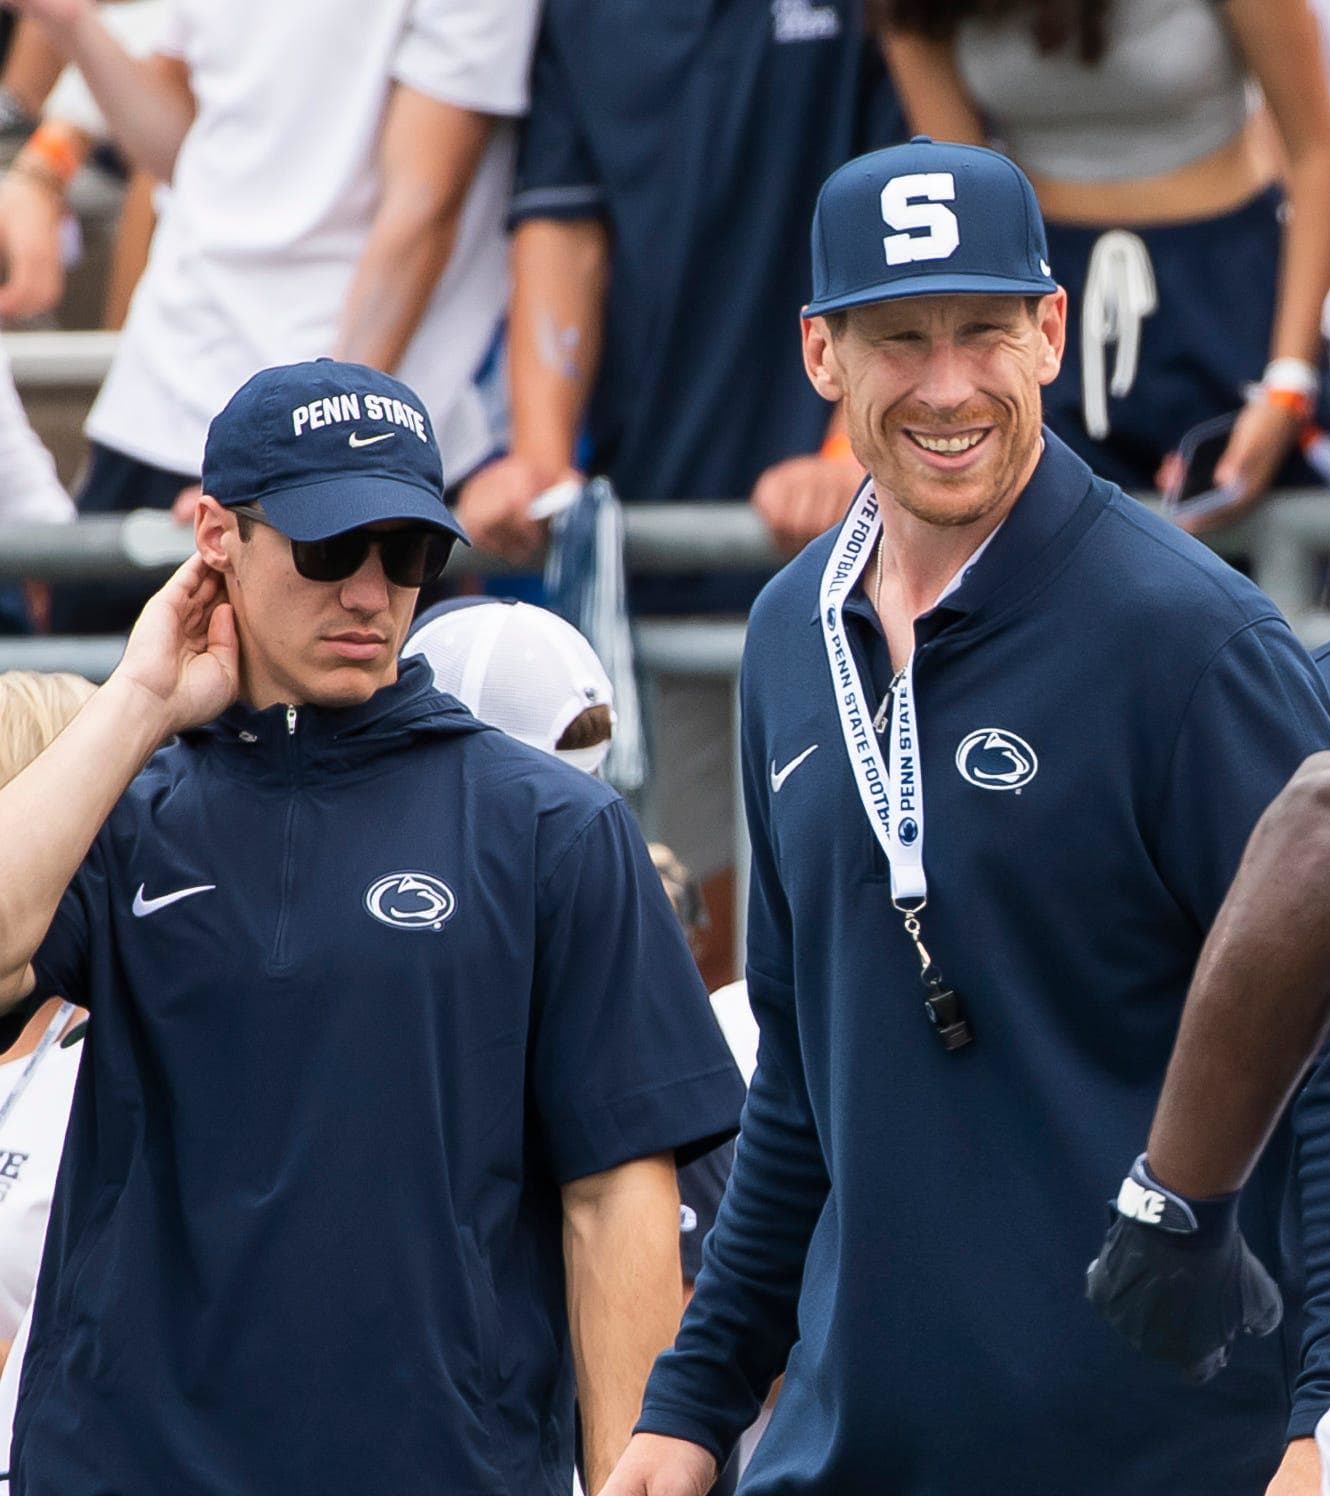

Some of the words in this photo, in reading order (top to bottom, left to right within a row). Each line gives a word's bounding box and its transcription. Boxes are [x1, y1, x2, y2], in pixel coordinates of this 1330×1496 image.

[880, 172, 960, 266] S
[292, 393, 360, 436] PENN
[363, 394, 427, 443] STATE
[827, 519, 871, 598] FOOTBALL
[831, 635, 853, 689] PENN
[844, 691, 870, 752] STATE
[898, 683, 912, 751] STATE
[900, 755, 916, 812] PENN
